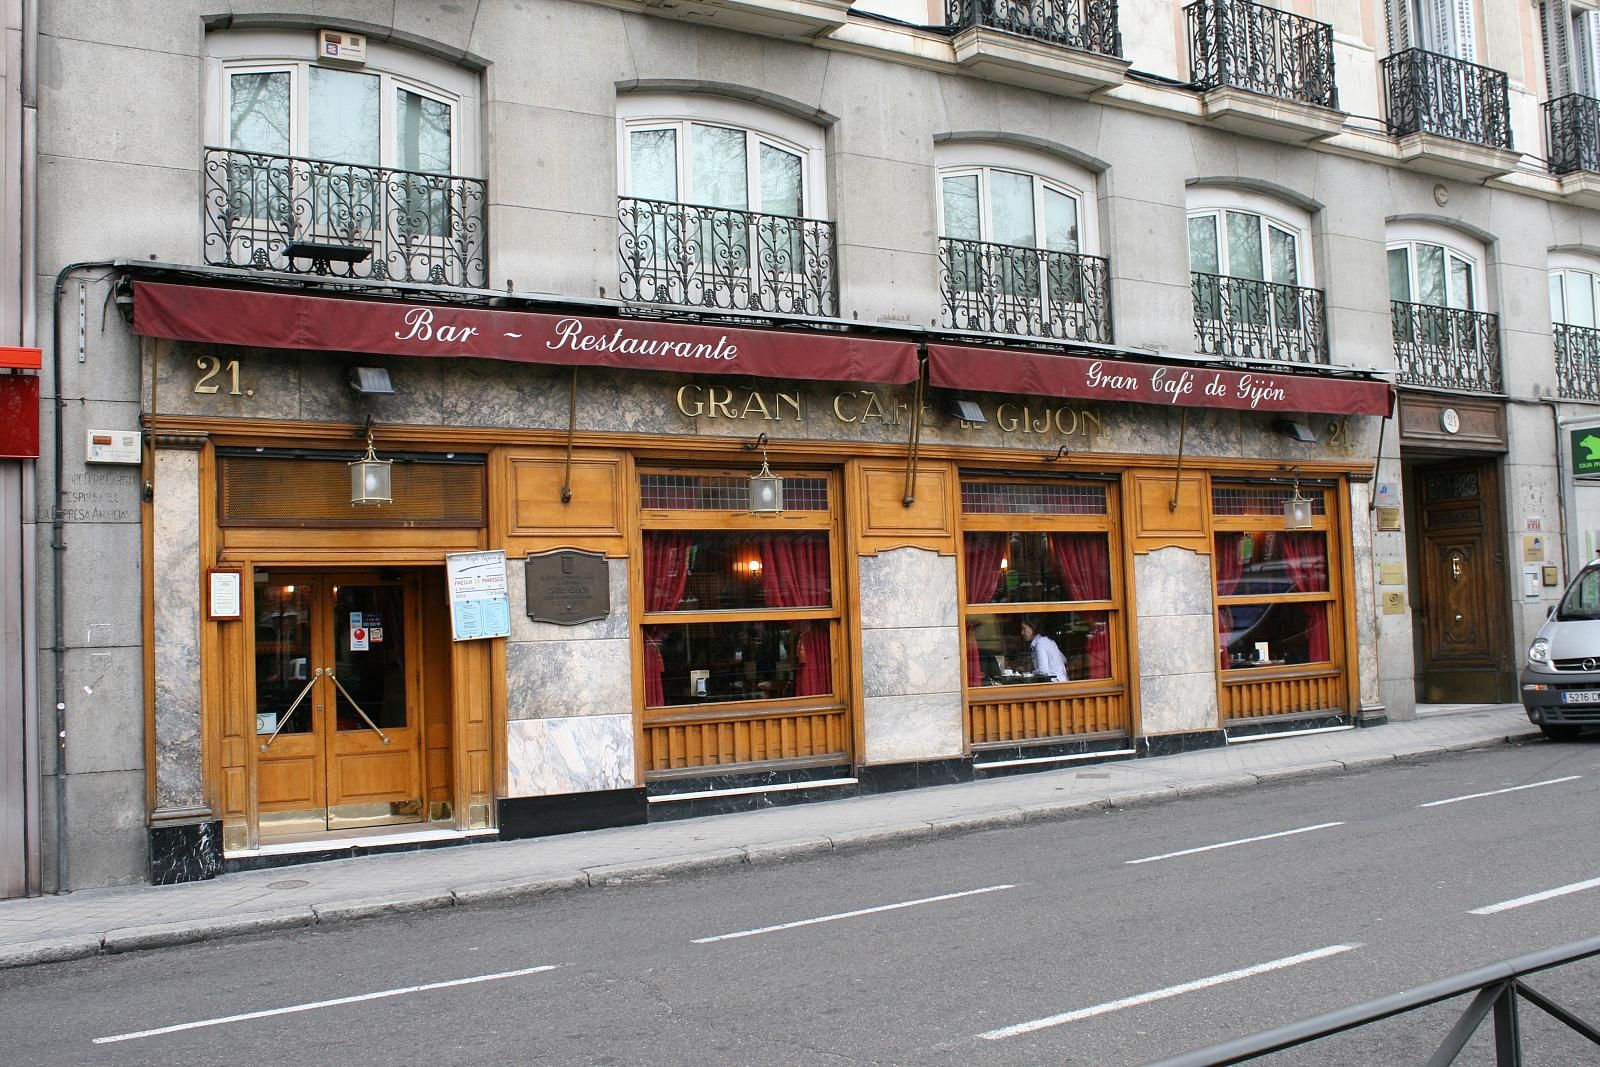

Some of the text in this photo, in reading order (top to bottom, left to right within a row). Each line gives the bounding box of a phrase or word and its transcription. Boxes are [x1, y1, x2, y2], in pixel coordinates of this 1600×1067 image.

[395, 308, 479, 342] Bar
[546, 318, 738, 360] Restaurante
[677, 384, 803, 421] GRAN
[1086, 361, 1286, 409] Gran Café de Gijón
[1447, 415, 1457, 428] 21
[1569, 693, 1589, 702] 5216
